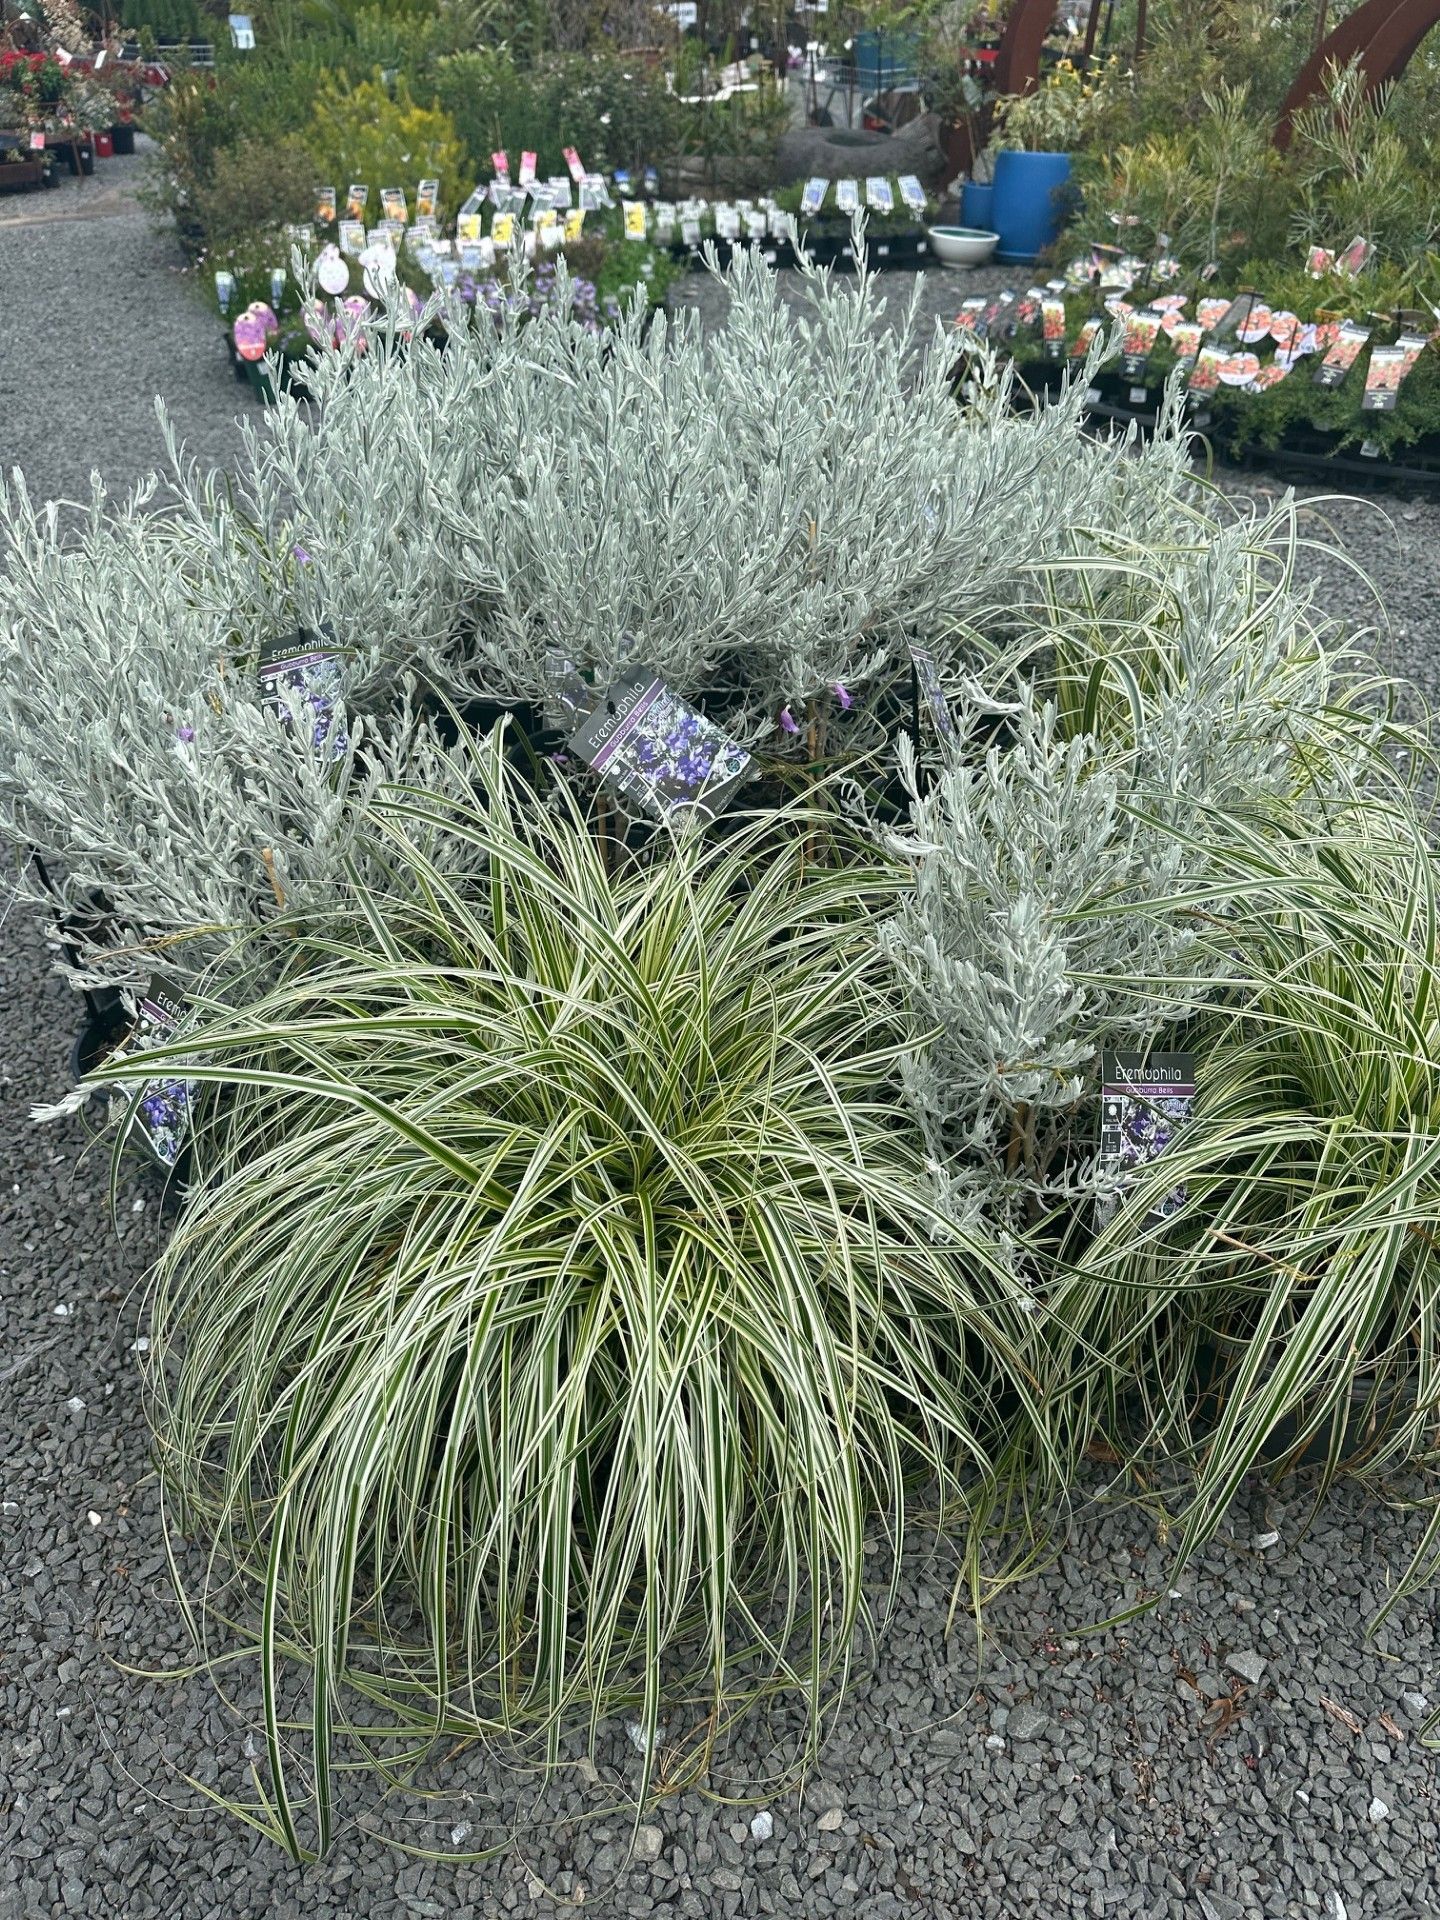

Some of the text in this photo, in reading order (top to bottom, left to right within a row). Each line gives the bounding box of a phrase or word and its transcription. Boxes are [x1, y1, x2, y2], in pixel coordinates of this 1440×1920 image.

[588, 682, 645, 749] Eremophila
[609, 716, 636, 748] Gubburra
[633, 700, 649, 717] Bells
[1115, 1065, 1182, 1083] Eremophila
[1158, 1086, 1174, 1094] Bells
